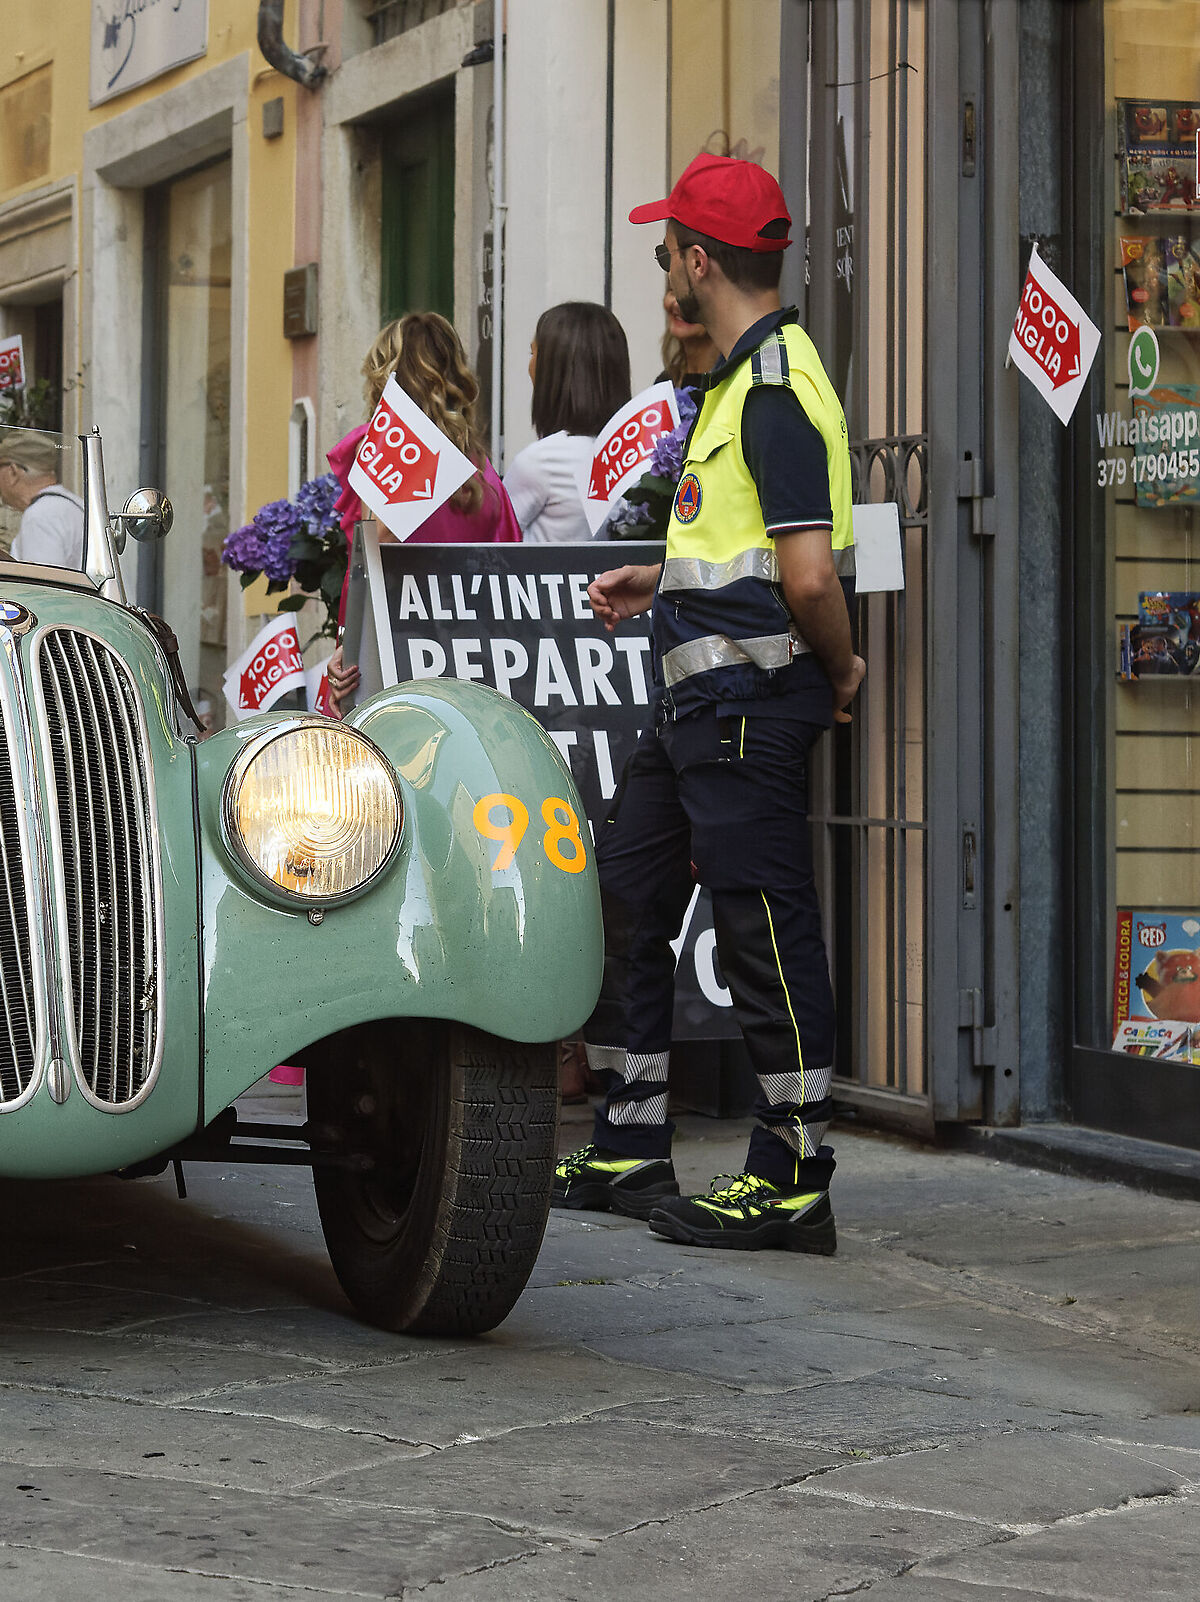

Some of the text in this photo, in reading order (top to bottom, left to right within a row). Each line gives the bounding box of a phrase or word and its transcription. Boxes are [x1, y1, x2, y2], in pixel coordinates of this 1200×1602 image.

[1025, 282, 1069, 344] 1000
[601, 409, 662, 466] 1000
[1096, 410, 1198, 448] Whatsapp
[1097, 449, 1200, 487] 379 1790455
[399, 574, 600, 620] ALL'INTE
[248, 633, 296, 681] 1000
[472, 792, 587, 875] 98
[1140, 927, 1166, 947] RED
